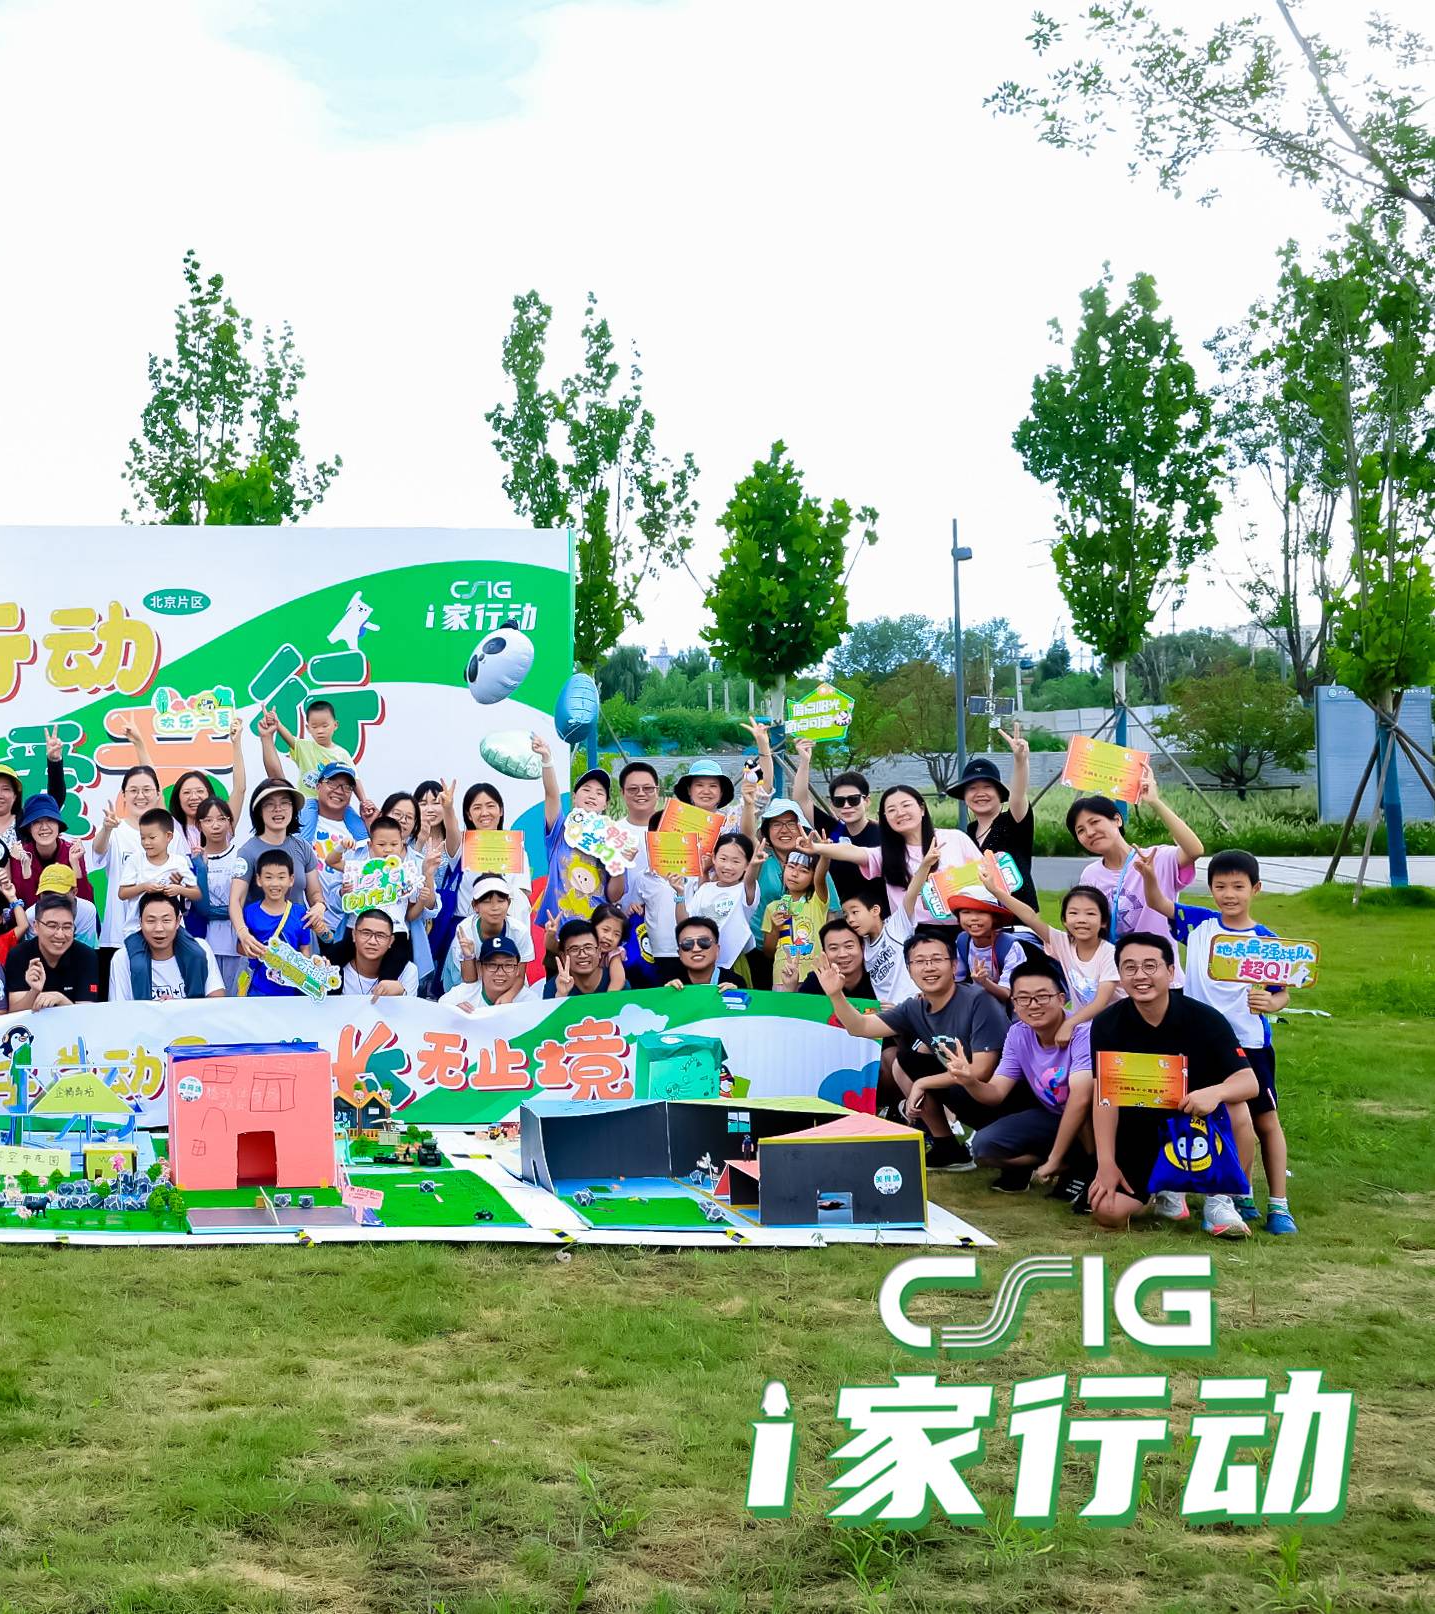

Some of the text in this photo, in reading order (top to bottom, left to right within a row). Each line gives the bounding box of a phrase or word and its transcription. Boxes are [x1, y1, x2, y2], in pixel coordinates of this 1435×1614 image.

[450, 580, 512, 599] CSIG
[149, 594, 204, 610] 北京片区
[160, 711, 230, 728] 欢乐一夏
[492, 937, 502, 948] C
[1216, 939, 1314, 962] 地表最强战队
